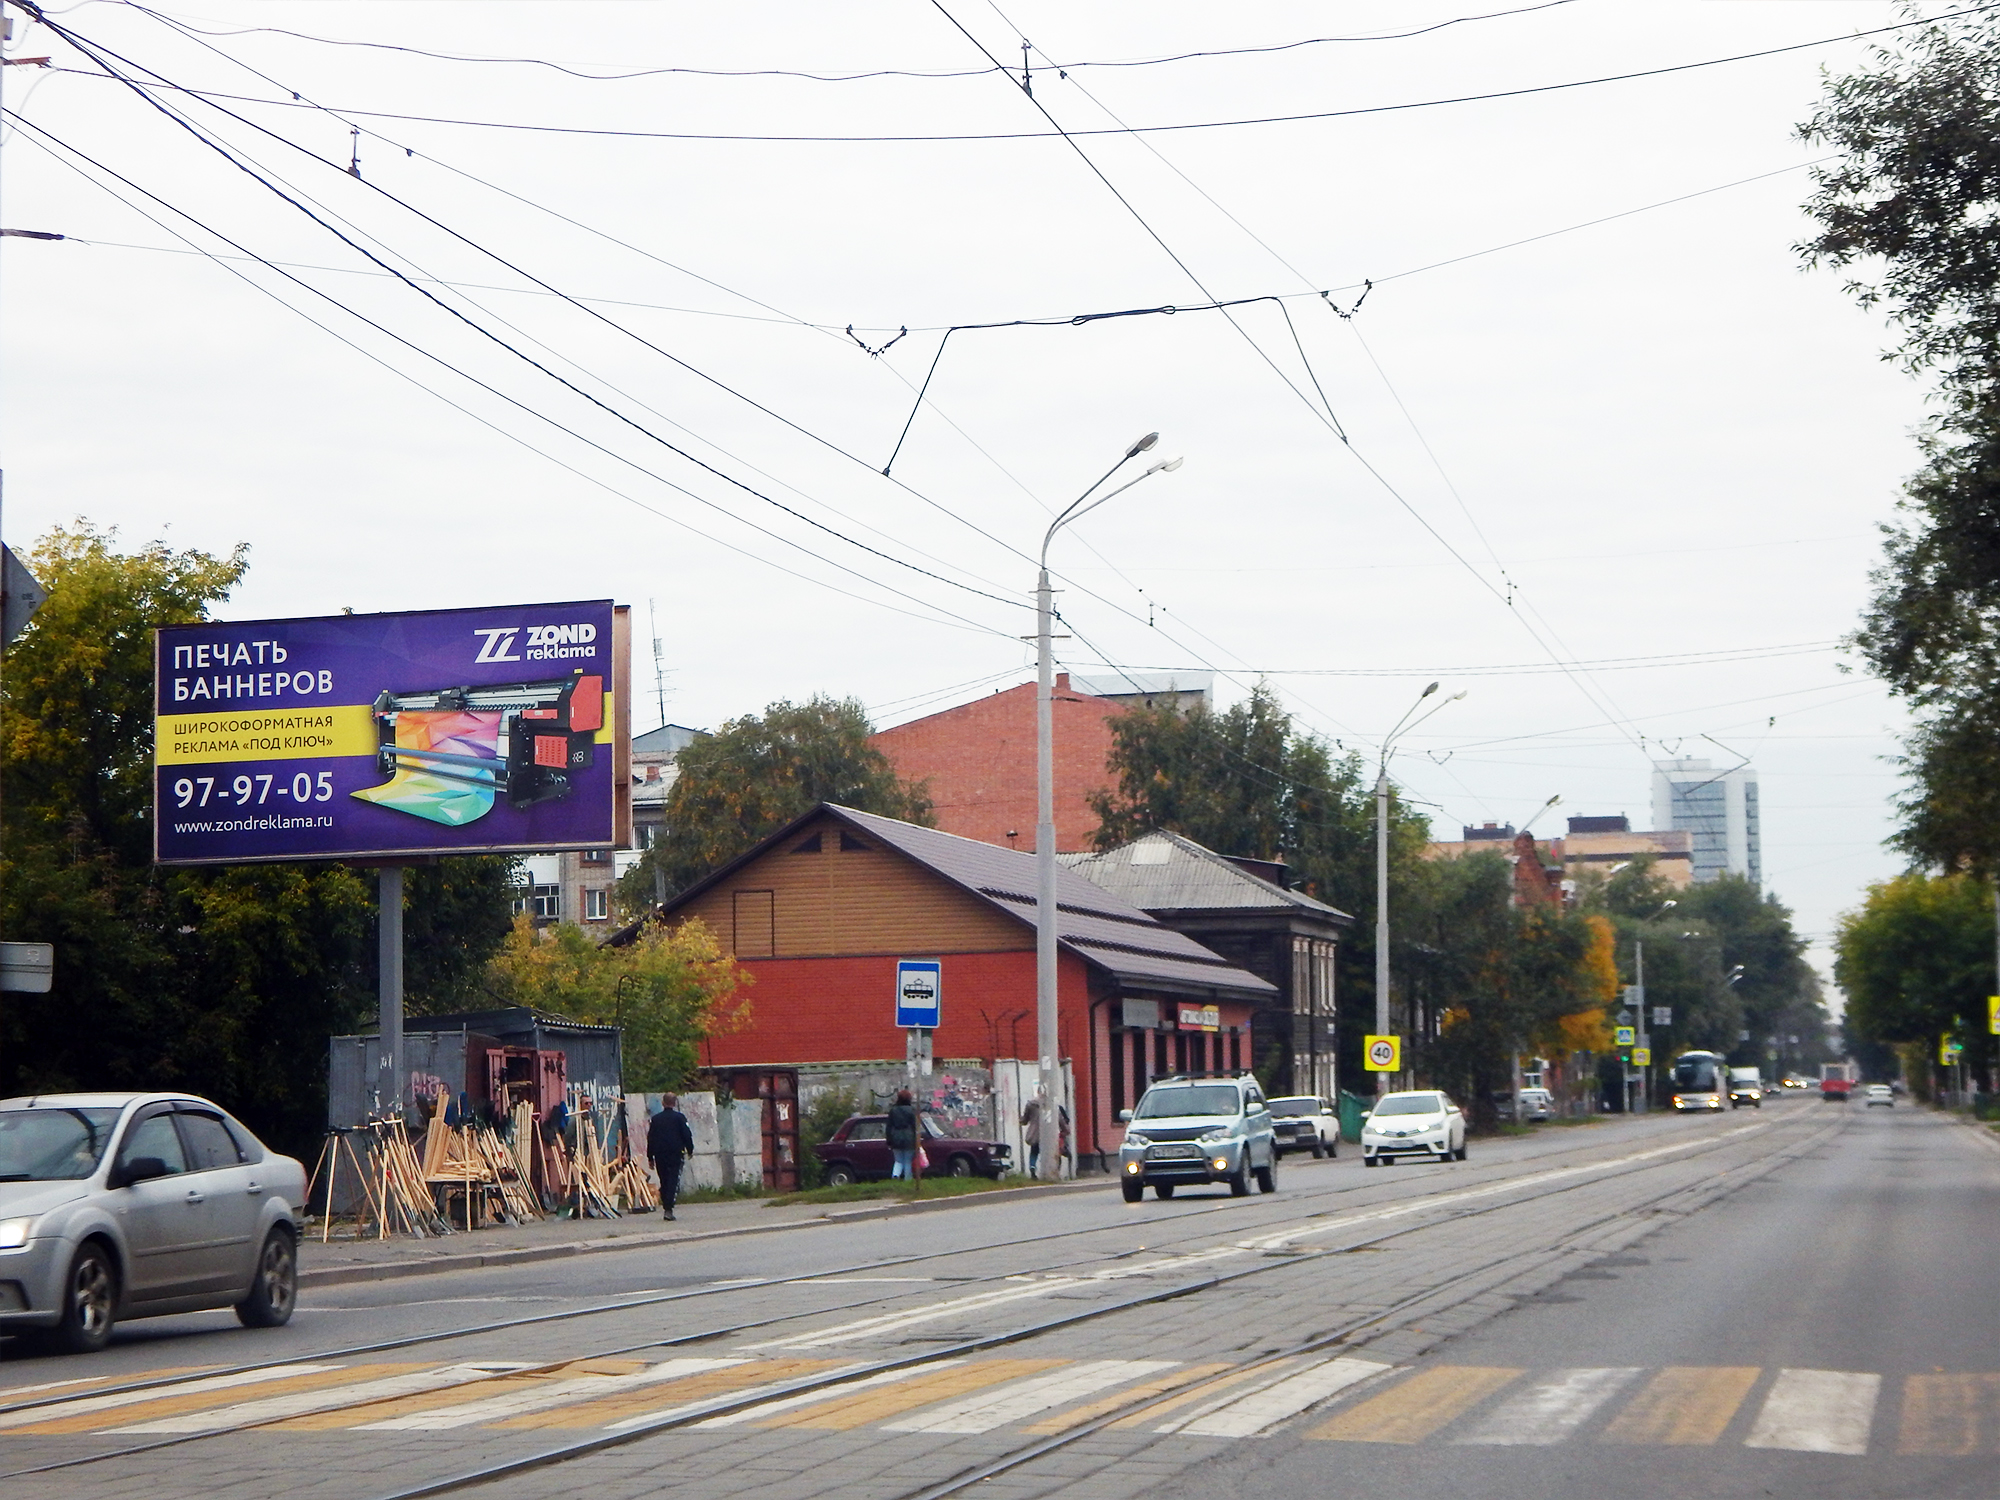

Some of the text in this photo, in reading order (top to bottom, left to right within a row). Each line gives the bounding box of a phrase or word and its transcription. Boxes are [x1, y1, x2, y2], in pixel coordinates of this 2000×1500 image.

[526, 623, 597, 646] ZOND
[174, 640, 288, 670] ПЕЧАТЬ
[526, 643, 596, 661] reklama
[174, 669, 333, 702] БАННЕРОВ
[174, 715, 333, 735] ШИРОКОФОРМАТНАЯ
[174, 735, 333, 754] РЕКЛАМА «ПОД КЛЮЧ»
[173, 771, 333, 809] 97-97-05
[174, 814, 333, 833] www.zondreklama.ru
[1373, 1046, 1391, 1059] 40
